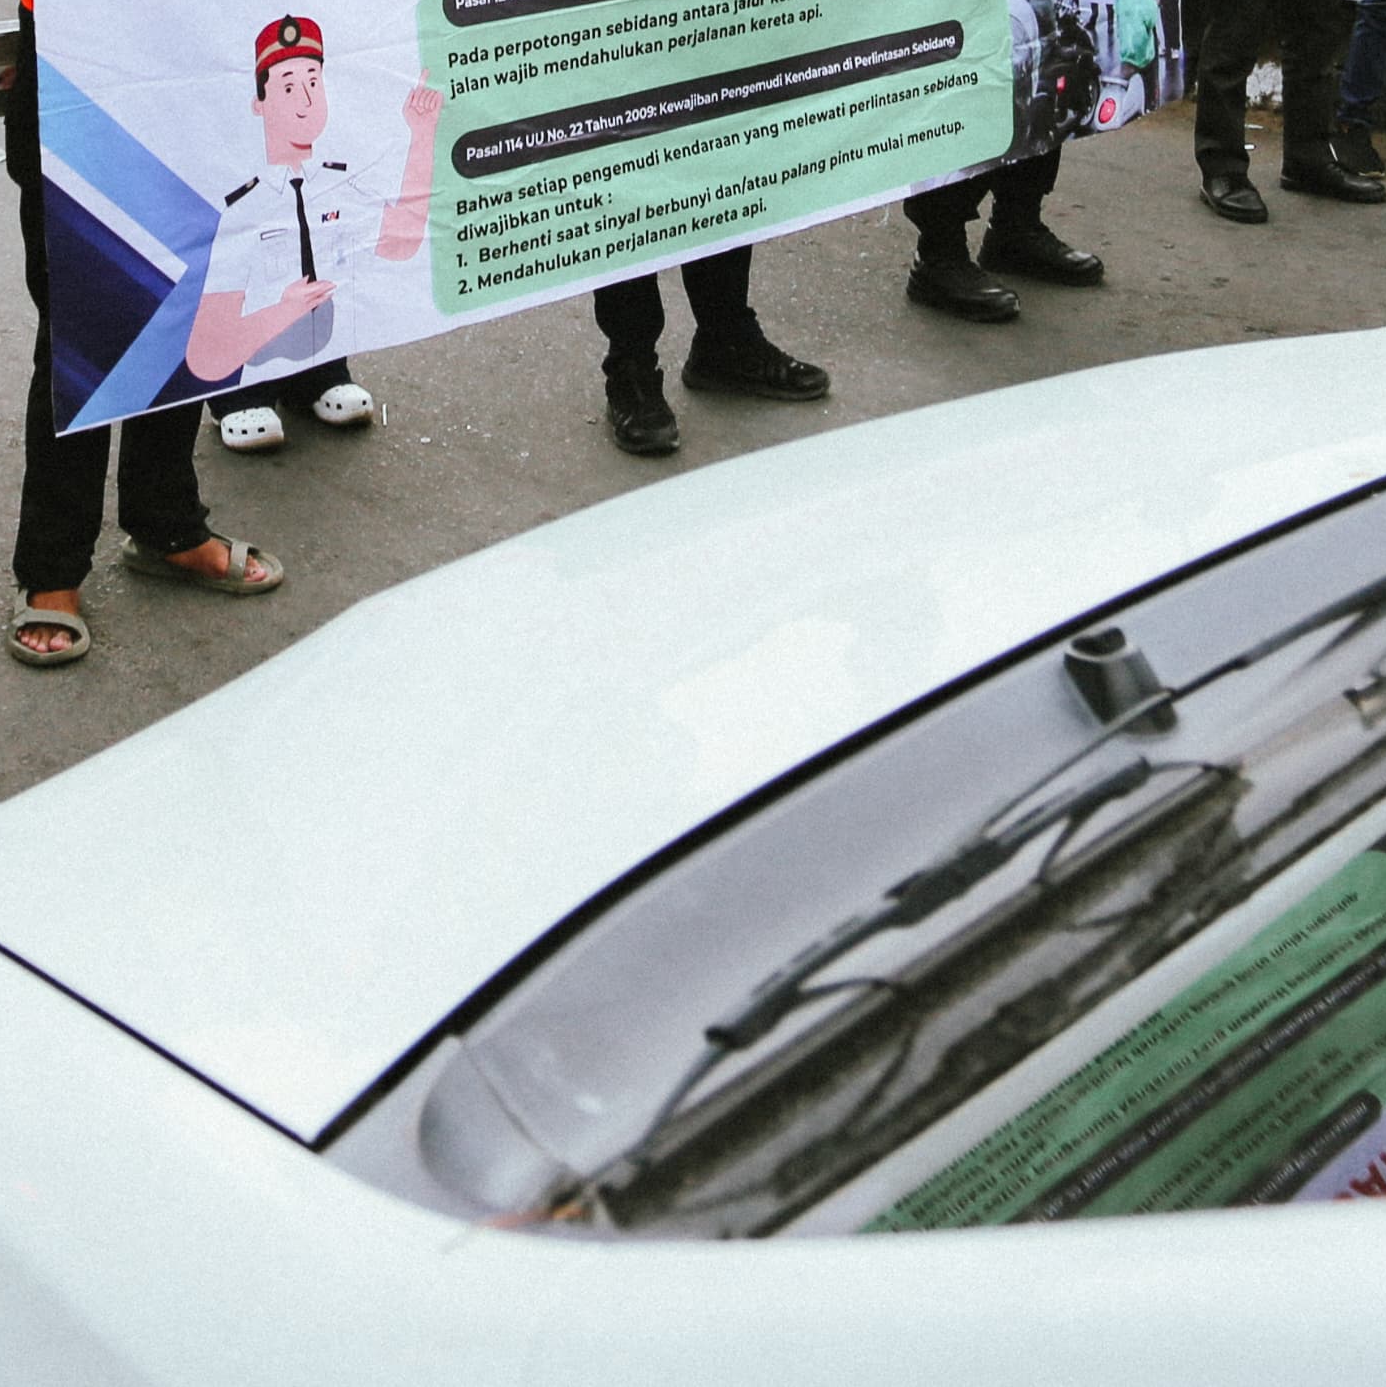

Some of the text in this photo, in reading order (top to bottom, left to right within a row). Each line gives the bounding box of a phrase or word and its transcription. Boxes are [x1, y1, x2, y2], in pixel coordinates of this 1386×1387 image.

[448, 47, 489, 68] Pada
[494, 27, 601, 61] perpotongan
[606, 12, 678, 37] sebidang
[682, 0, 730, 22] antara
[450, 5, 823, 99] jalan wajib mendahulukan perjalanan kereta api.
[456, 70, 979, 216] Bahwa setiap pengemudi kendaraan yang melewati perlintasan sebidang
[466, 34, 955, 161] Pasal 114 UU No. 22 Tahun 2009: Kewajiban Pengemudi Kendaraan di Perlintasan Sebidang
[456, 120, 965, 268] 1. Berhenti saat sinyal berbunyi dan/atau palang pintu mulai menutup.
[456, 207, 550, 243] diwajibkan
[555, 195, 603, 217] untuk
[458, 198, 767, 295] 2. Mendahulukan perjalanan kereta api.
